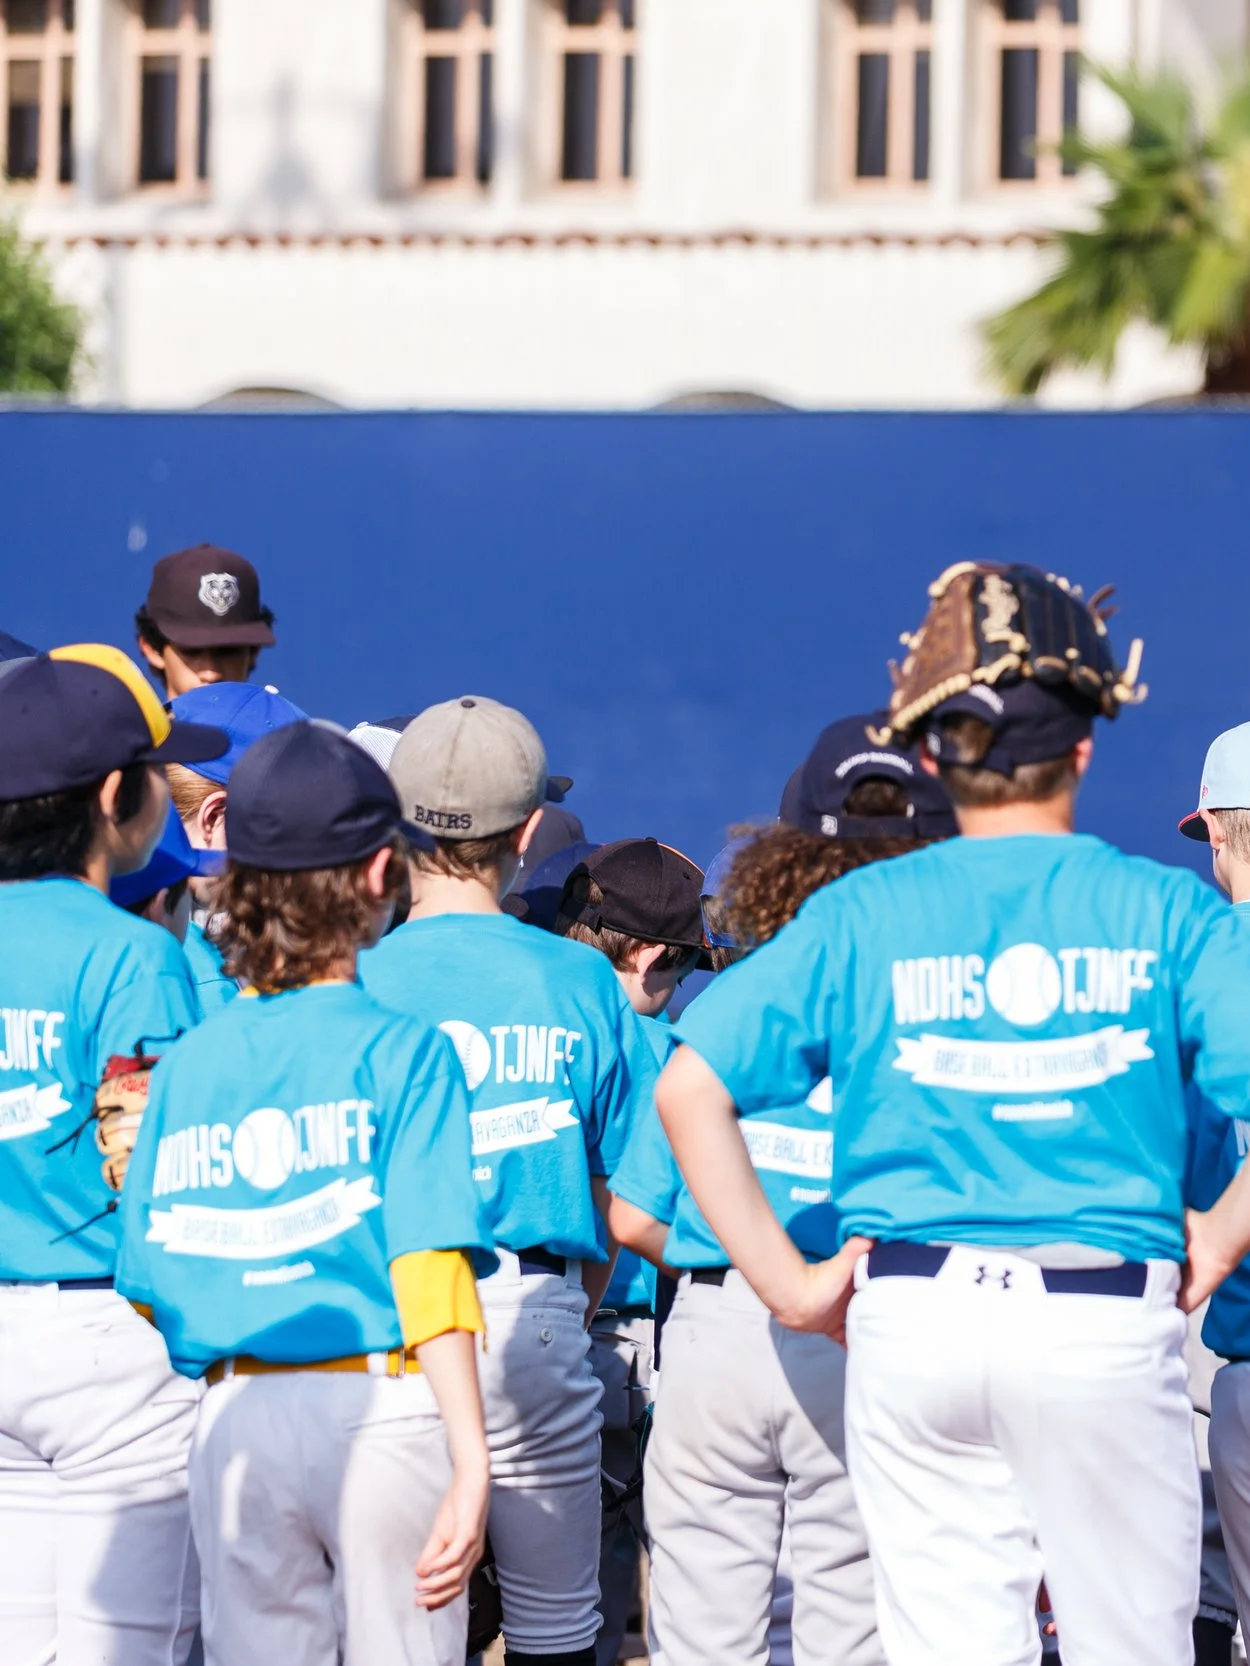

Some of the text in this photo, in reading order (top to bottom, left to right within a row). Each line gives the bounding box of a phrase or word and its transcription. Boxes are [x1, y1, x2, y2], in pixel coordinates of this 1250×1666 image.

[891, 946, 1160, 1026] NDHS TJNFF
[0, 1007, 66, 1071] JNFF
[151, 1099, 377, 1198] NDHS TJNFF
